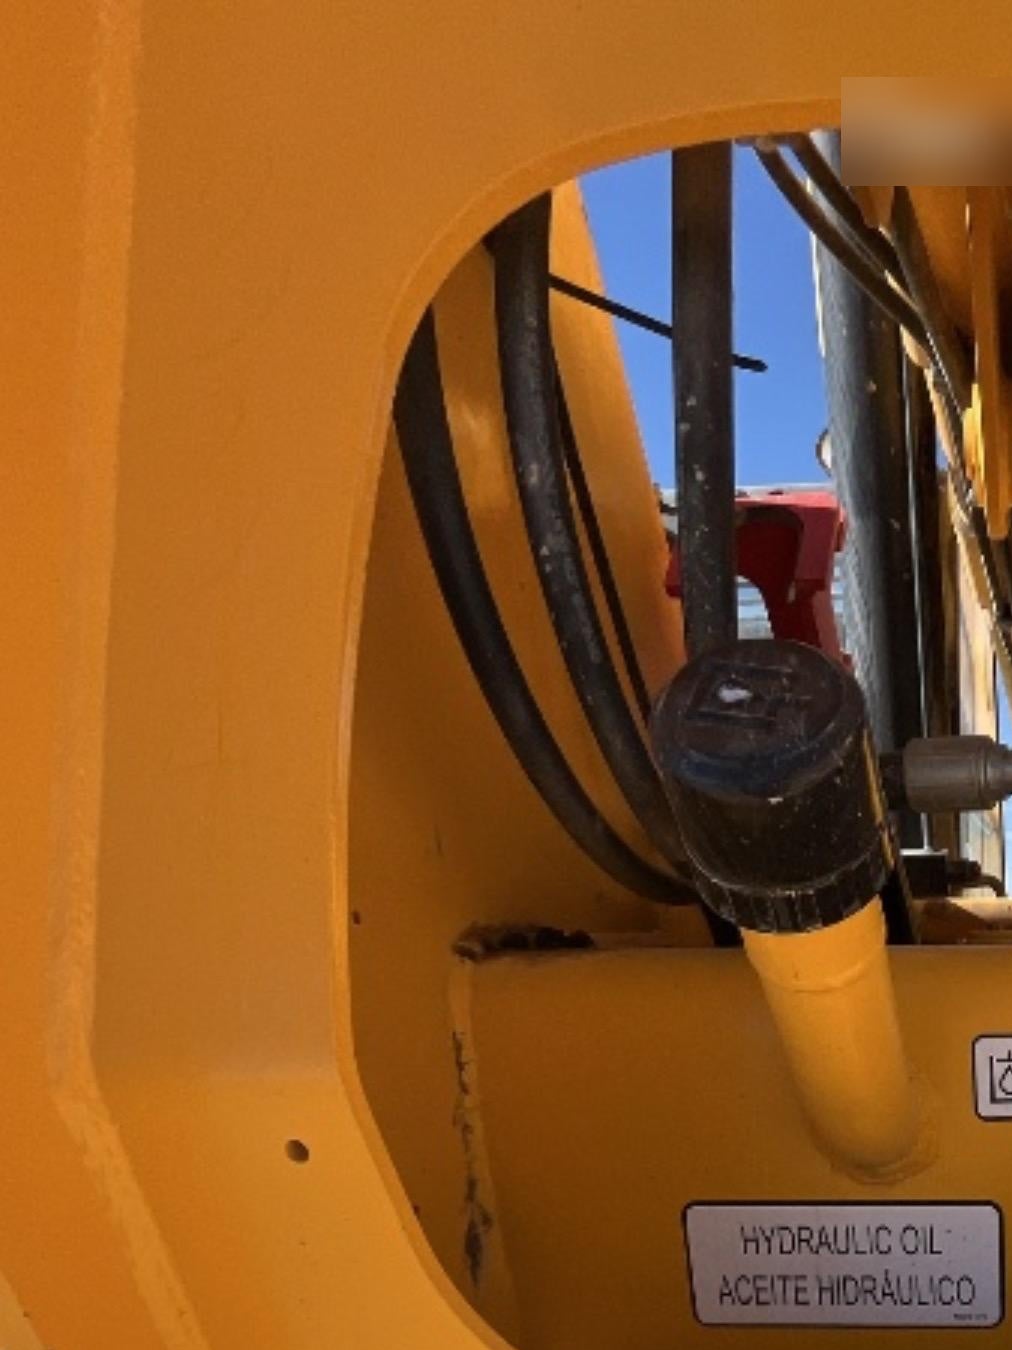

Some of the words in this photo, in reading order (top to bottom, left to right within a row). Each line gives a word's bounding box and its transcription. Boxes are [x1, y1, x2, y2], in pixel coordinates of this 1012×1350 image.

[740, 1224, 892, 1256] HYDRAULIC
[899, 1224, 943, 1256] OIL
[719, 1273, 811, 1307] ACEITE
[816, 1267, 976, 1307] HIDRÁULICO
